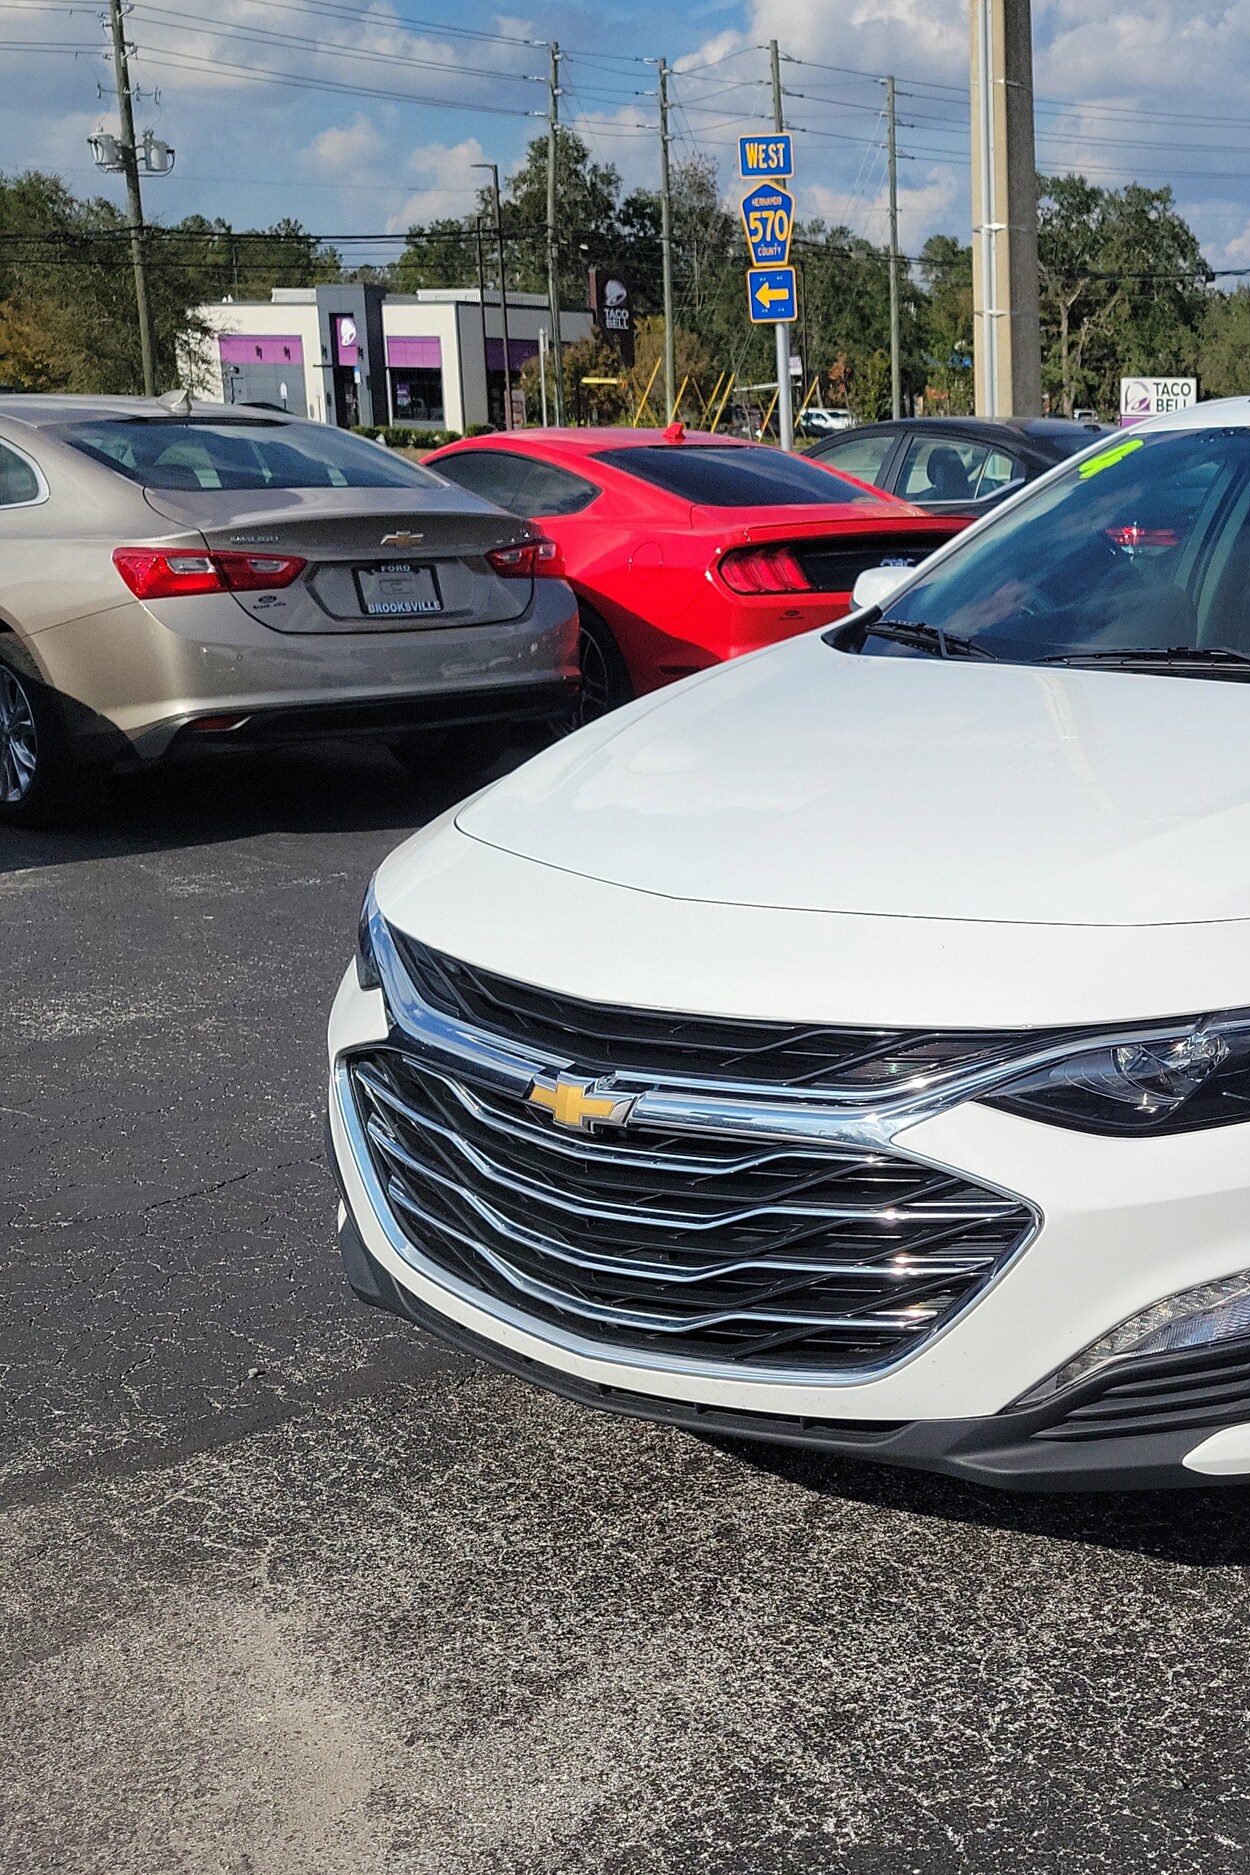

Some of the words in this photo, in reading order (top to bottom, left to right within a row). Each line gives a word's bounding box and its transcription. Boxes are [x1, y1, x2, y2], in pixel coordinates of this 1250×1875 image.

[745, 142, 785, 169] WEST
[749, 209, 789, 243] 570
[757, 246, 781, 257] COUNTY
[603, 308, 629, 320] TACO
[606, 319, 629, 330] BELL
[1153, 382, 1192, 397] TACO
[381, 564, 411, 573] FORD
[367, 601, 441, 614] BROOKSVILLE
